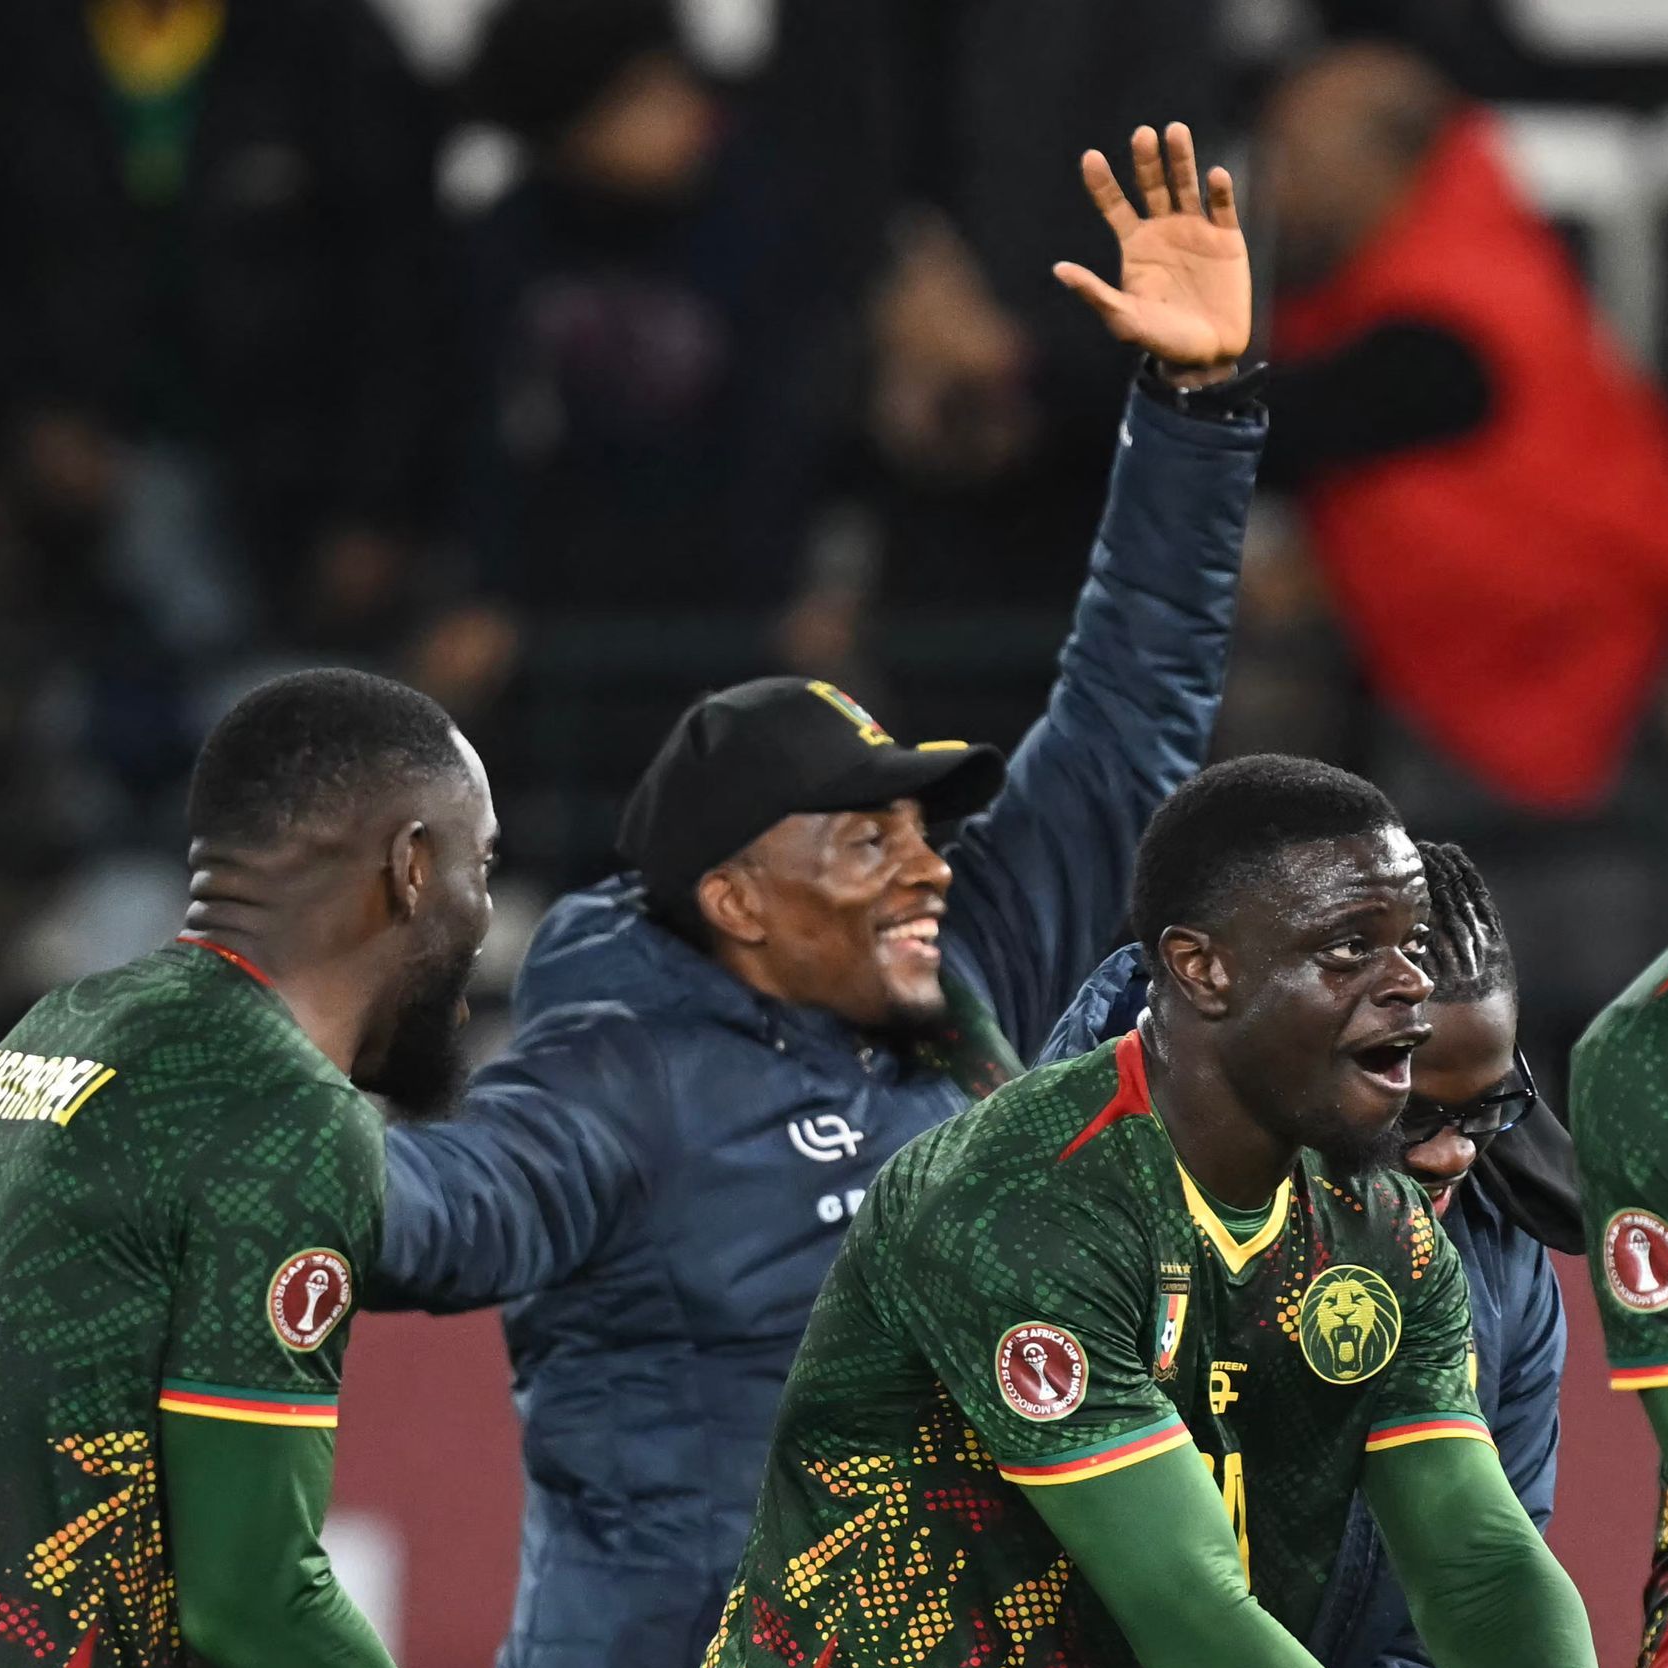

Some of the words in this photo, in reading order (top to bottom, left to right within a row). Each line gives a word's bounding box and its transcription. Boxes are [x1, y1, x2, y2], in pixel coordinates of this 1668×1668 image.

[1030, 1328, 1065, 1346] AFRICA
[1063, 1342, 1079, 1361] CUP
[1001, 1369, 1011, 1381] 25
[1072, 1362, 1082, 1377] OF
[1210, 1361, 1248, 1372] RTEEN
[1005, 1382, 1051, 1415] MOROCCO
[1051, 1377, 1080, 1412] NATIONS
